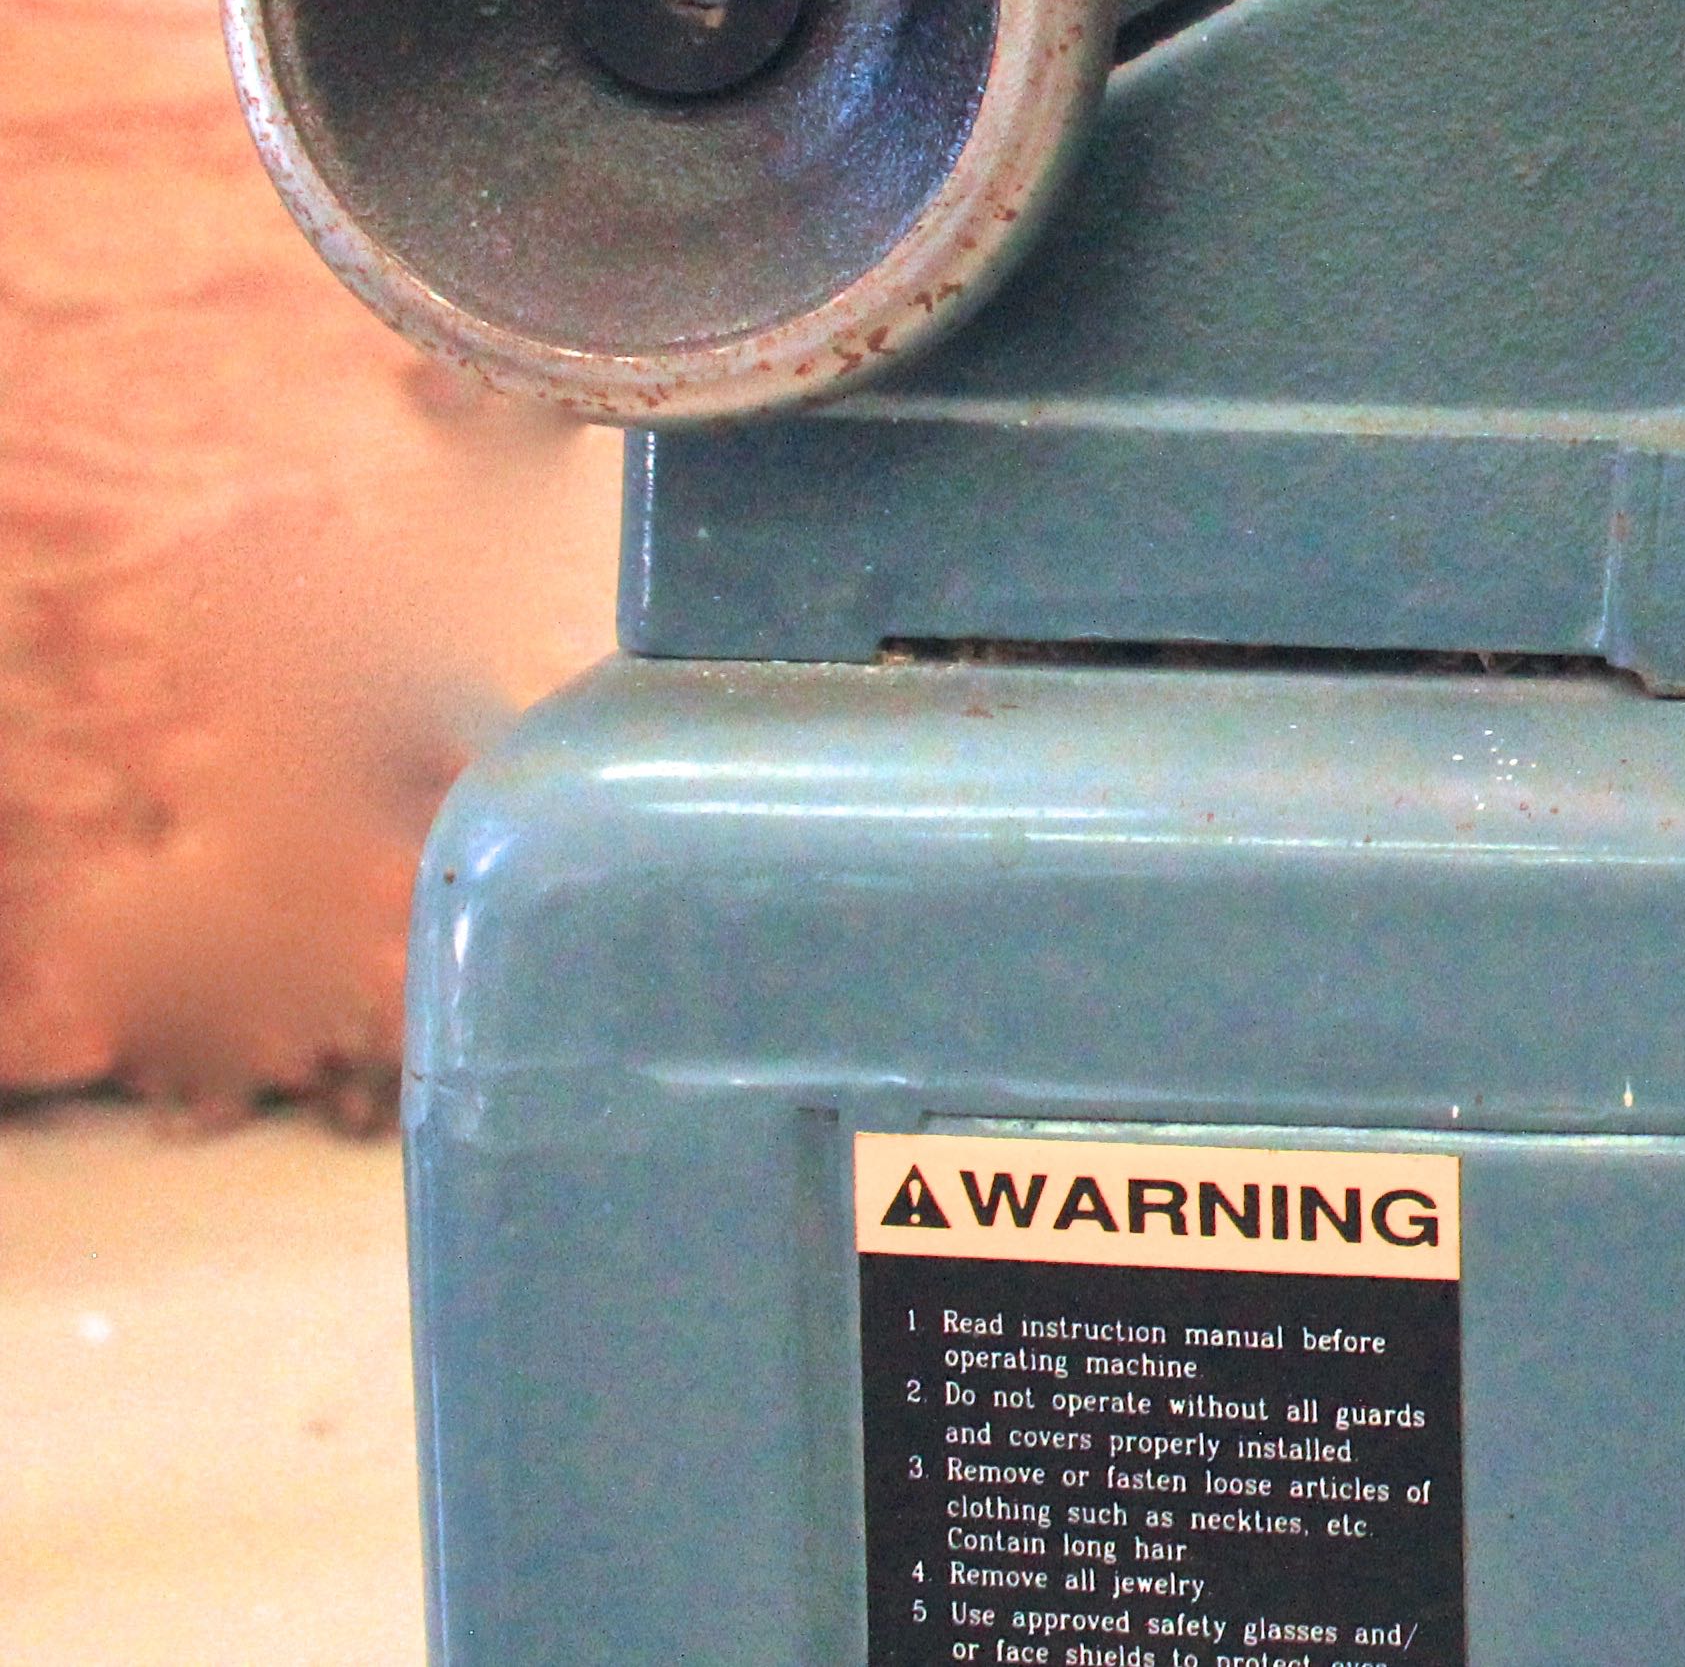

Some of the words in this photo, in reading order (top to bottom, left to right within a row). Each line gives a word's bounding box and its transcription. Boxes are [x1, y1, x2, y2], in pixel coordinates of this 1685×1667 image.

[960, 1169, 1440, 1248] WARNING
[943, 1310, 1003, 1334] Read
[1021, 1314, 1166, 1344] instruction
[1185, 1325, 1283, 1349] manual
[1302, 1327, 1386, 1353] before
[944, 1348, 1069, 1378] operating
[945, 1381, 976, 1406] Do
[994, 1388, 1035, 1408] not
[1052, 1392, 1151, 1417] operate
[1169, 1394, 1269, 1421] without
[1287, 1399, 1317, 1423] all
[1336, 1403, 1425, 1430] guards
[946, 1422, 992, 1445] and
[1009, 1430, 1092, 1449] covers
[1110, 1433, 1220, 1462] properly
[1238, 1435, 1358, 1462] installed.
[947, 1456, 1046, 1484] Remove
[1062, 1470, 1090, 1486] or
[1107, 1465, 1186, 1492] fasten
[1205, 1470, 1272, 1496] loose
[1290, 1476, 1390, 1501] articles
[1407, 1480, 1431, 1504] of
[947, 1495, 1051, 1527] clothing
[1067, 1502, 1127, 1525] such
[1146, 1511, 1174, 1527] as
[1191, 1508, 1309, 1536] neckties,
[1327, 1514, 1373, 1537] etc.
[948, 1527, 1046, 1554] Contain
[1063, 1533, 1117, 1564] long
[950, 1561, 1048, 1588] Remove
[1065, 1568, 1095, 1591] all
[951, 1601, 995, 1626] Use
[1012, 1611, 1130, 1636] approved
[1148, 1613, 1226, 1644] safety
[1244, 1617, 1338, 1645] glasses
[1355, 1623, 1418, 1651] and/
[952, 1643, 980, 1660] or
[997, 1639, 1049, 1663] face
[1065, 1643, 1155, 1667] shields
[1173, 1648, 1198, 1667] to
